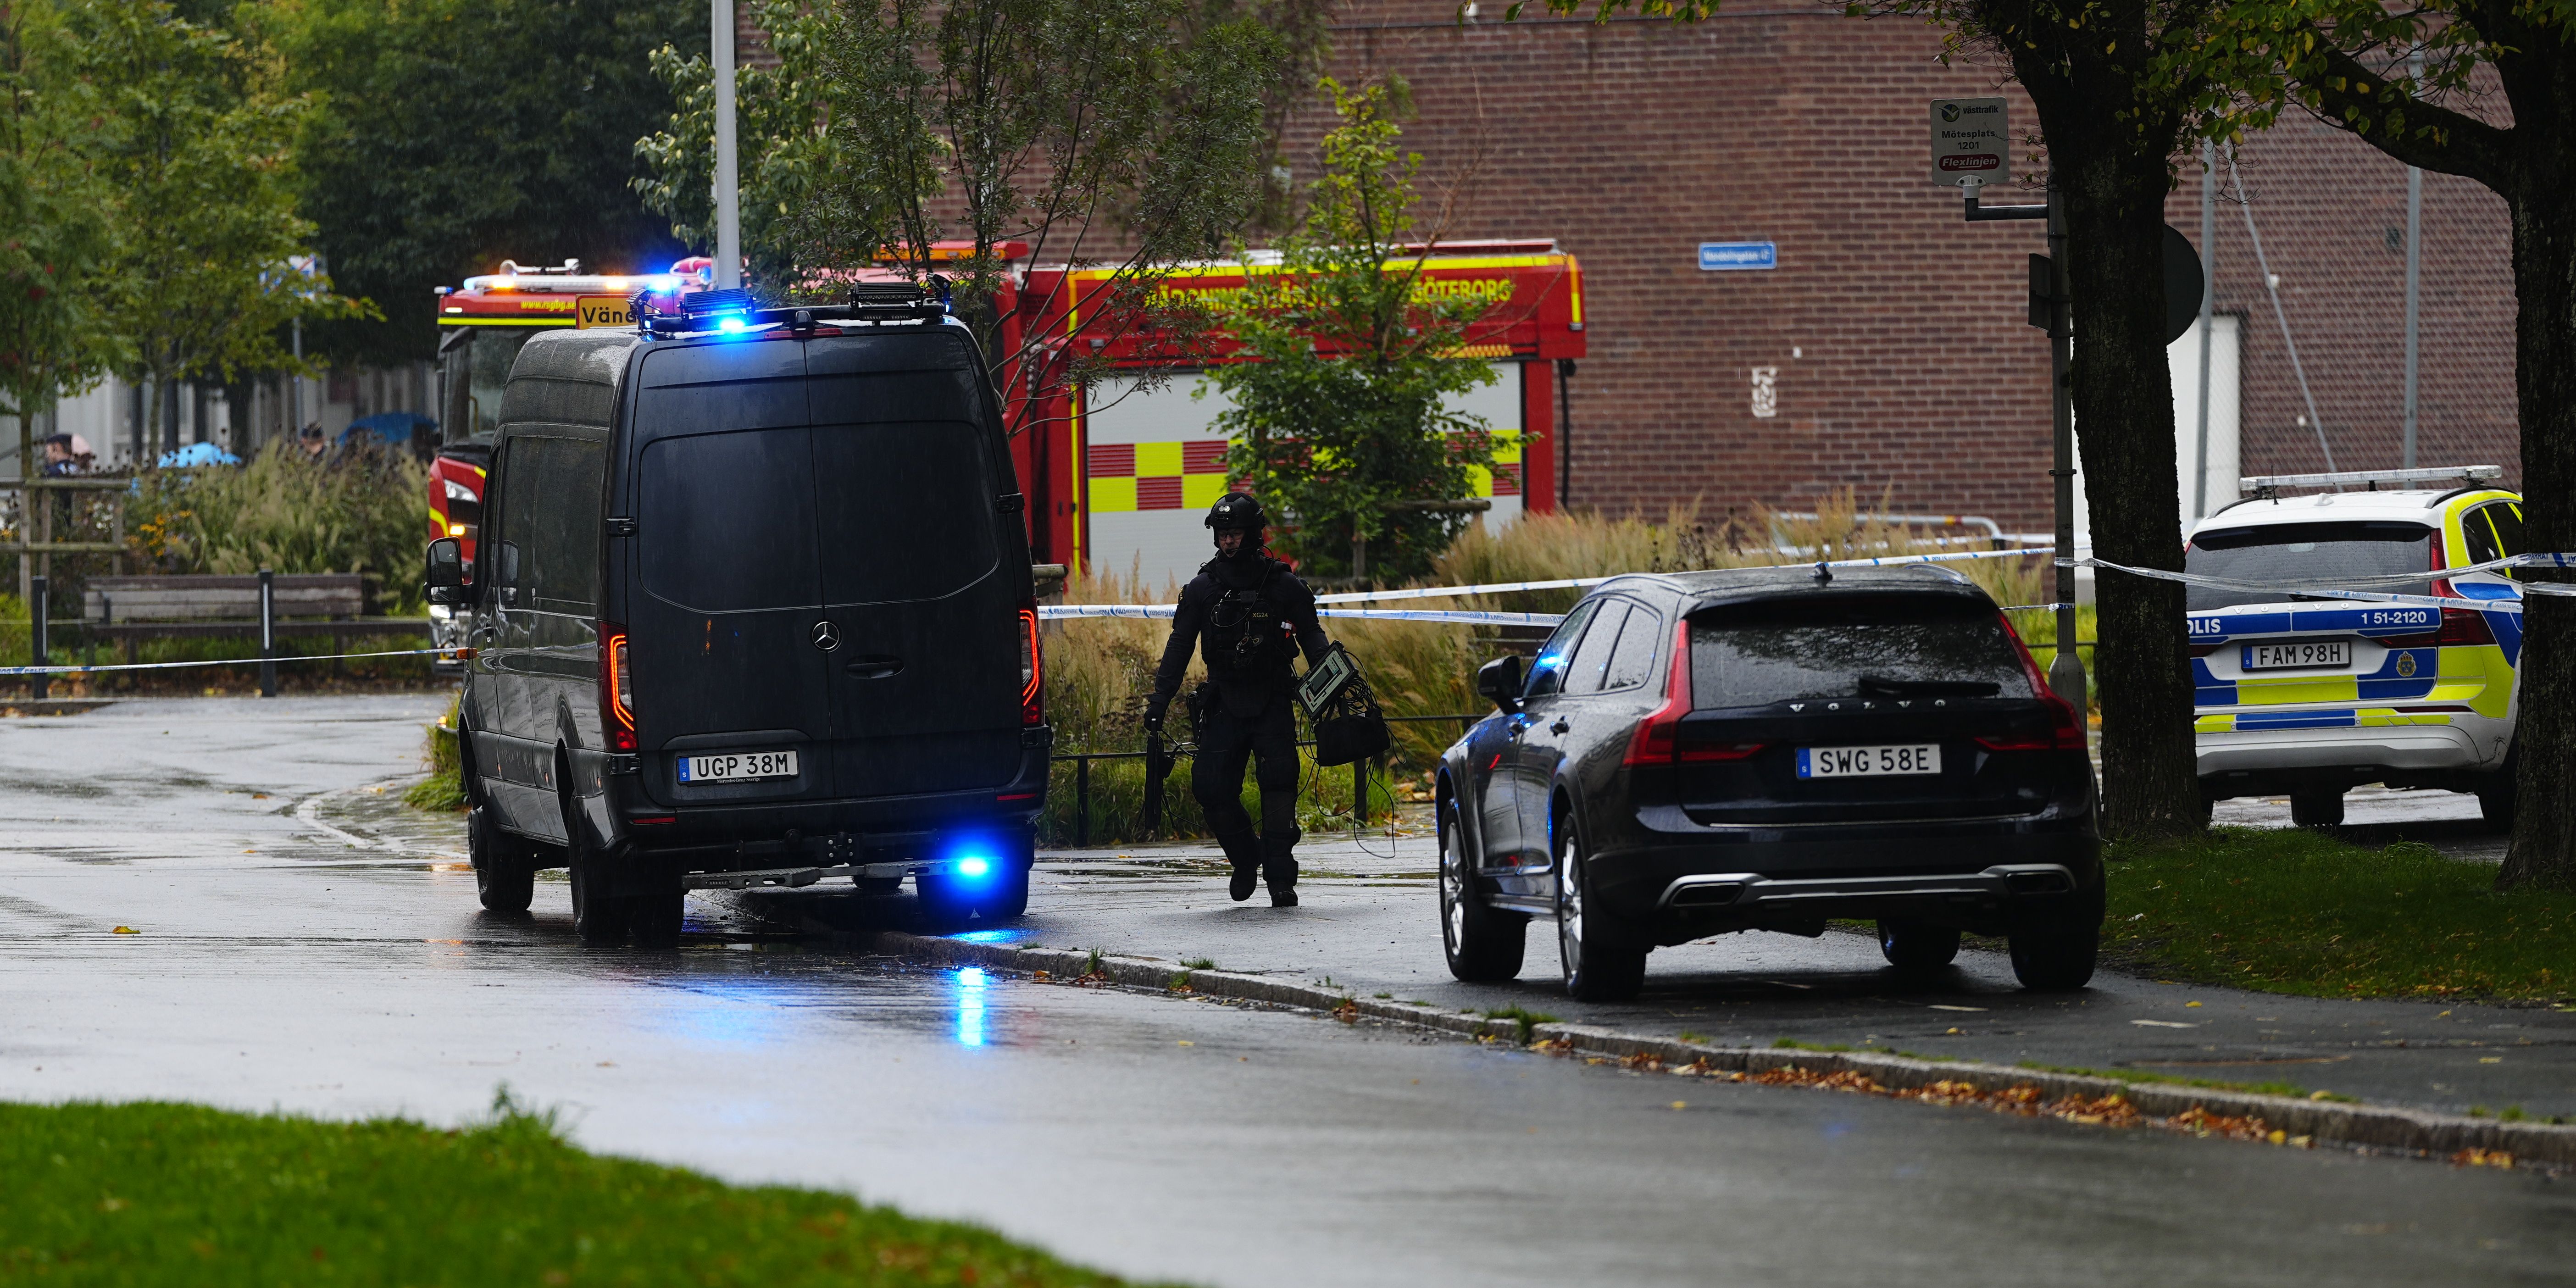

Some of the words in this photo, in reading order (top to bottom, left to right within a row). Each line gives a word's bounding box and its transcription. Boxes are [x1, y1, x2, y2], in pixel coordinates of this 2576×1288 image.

[1963, 105, 1999, 114] västtrafik
[1942, 130, 1995, 139] Mötesplats
[1958, 142, 1979, 150] 1201
[1943, 158, 1996, 168] Flexlinjen
[2234, 602, 2349, 614] VOLVO
[2361, 613, 2368, 624] 1
[2373, 611, 2426, 624] 51-2120
[2186, 618, 2221, 634] OLIS
[2260, 645, 2297, 666] FAM
[2303, 643, 2341, 663] 98H
[1789, 699, 1946, 712] VOLVO
[697, 757, 738, 777] UGP
[747, 754, 788, 774] 38M
[1820, 750, 1869, 773] SWG
[1881, 748, 1929, 771] 58E
